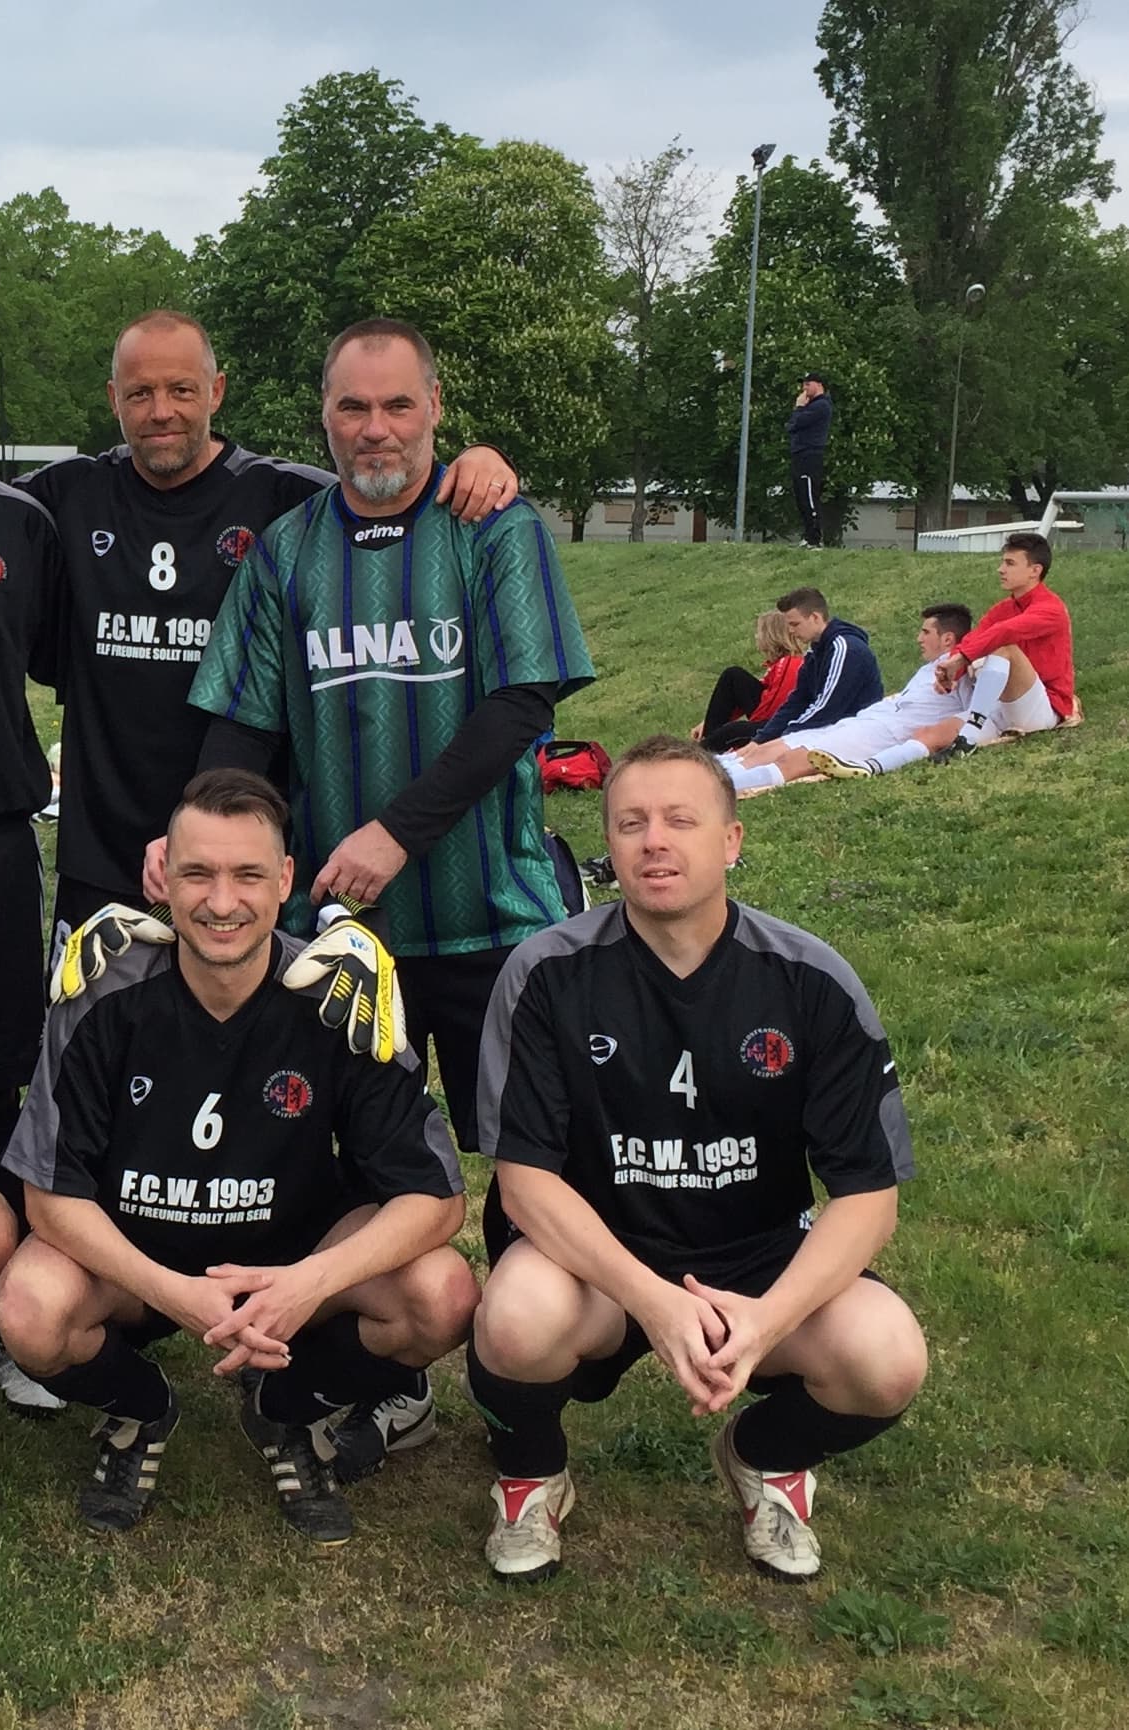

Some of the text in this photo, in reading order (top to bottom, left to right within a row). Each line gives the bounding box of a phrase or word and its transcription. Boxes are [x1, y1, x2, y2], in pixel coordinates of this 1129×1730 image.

[354, 524, 405, 543] erima
[148, 541, 177, 591] 8
[97, 612, 216, 647] F.C.W. 199
[306, 619, 422, 671] ALNA
[95, 642, 111, 656] ELF
[111, 644, 152, 660] FREUNDE
[152, 646, 182, 662] SOLLT
[669, 1049, 698, 1110] 4
[192, 1092, 223, 1150] 6
[610, 1134, 758, 1173] F.C.W. 1993
[120, 1169, 276, 1209] F.C.W. 1993
[629, 1169, 679, 1189] FREUNDE
[679, 1174, 713, 1190] SOLLT
[119, 1201, 138, 1215] ELF
[138, 1205, 189, 1224] FREUNDE
[190, 1211, 224, 1225] SOLLT
[246, 1207, 271, 1222] SEIN
